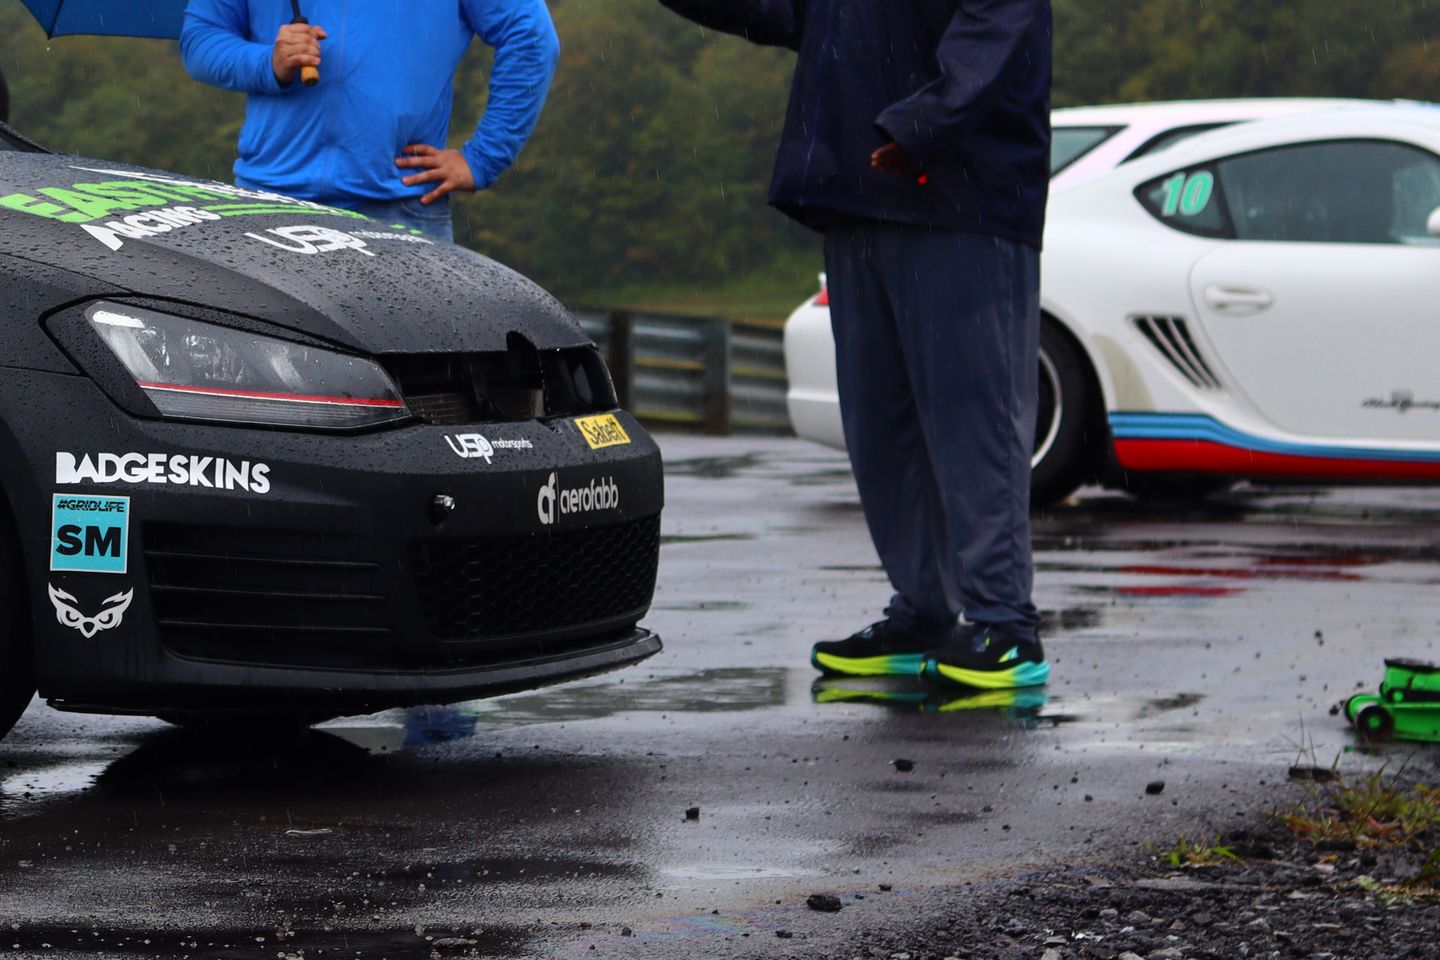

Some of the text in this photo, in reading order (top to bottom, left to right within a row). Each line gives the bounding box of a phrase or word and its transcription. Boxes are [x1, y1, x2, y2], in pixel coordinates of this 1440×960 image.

[1161, 170, 1214, 216] 10
[55, 451, 271, 494] BADGESKINS
[559, 476, 619, 515] aerofabb
[55, 524, 122, 558] SM
